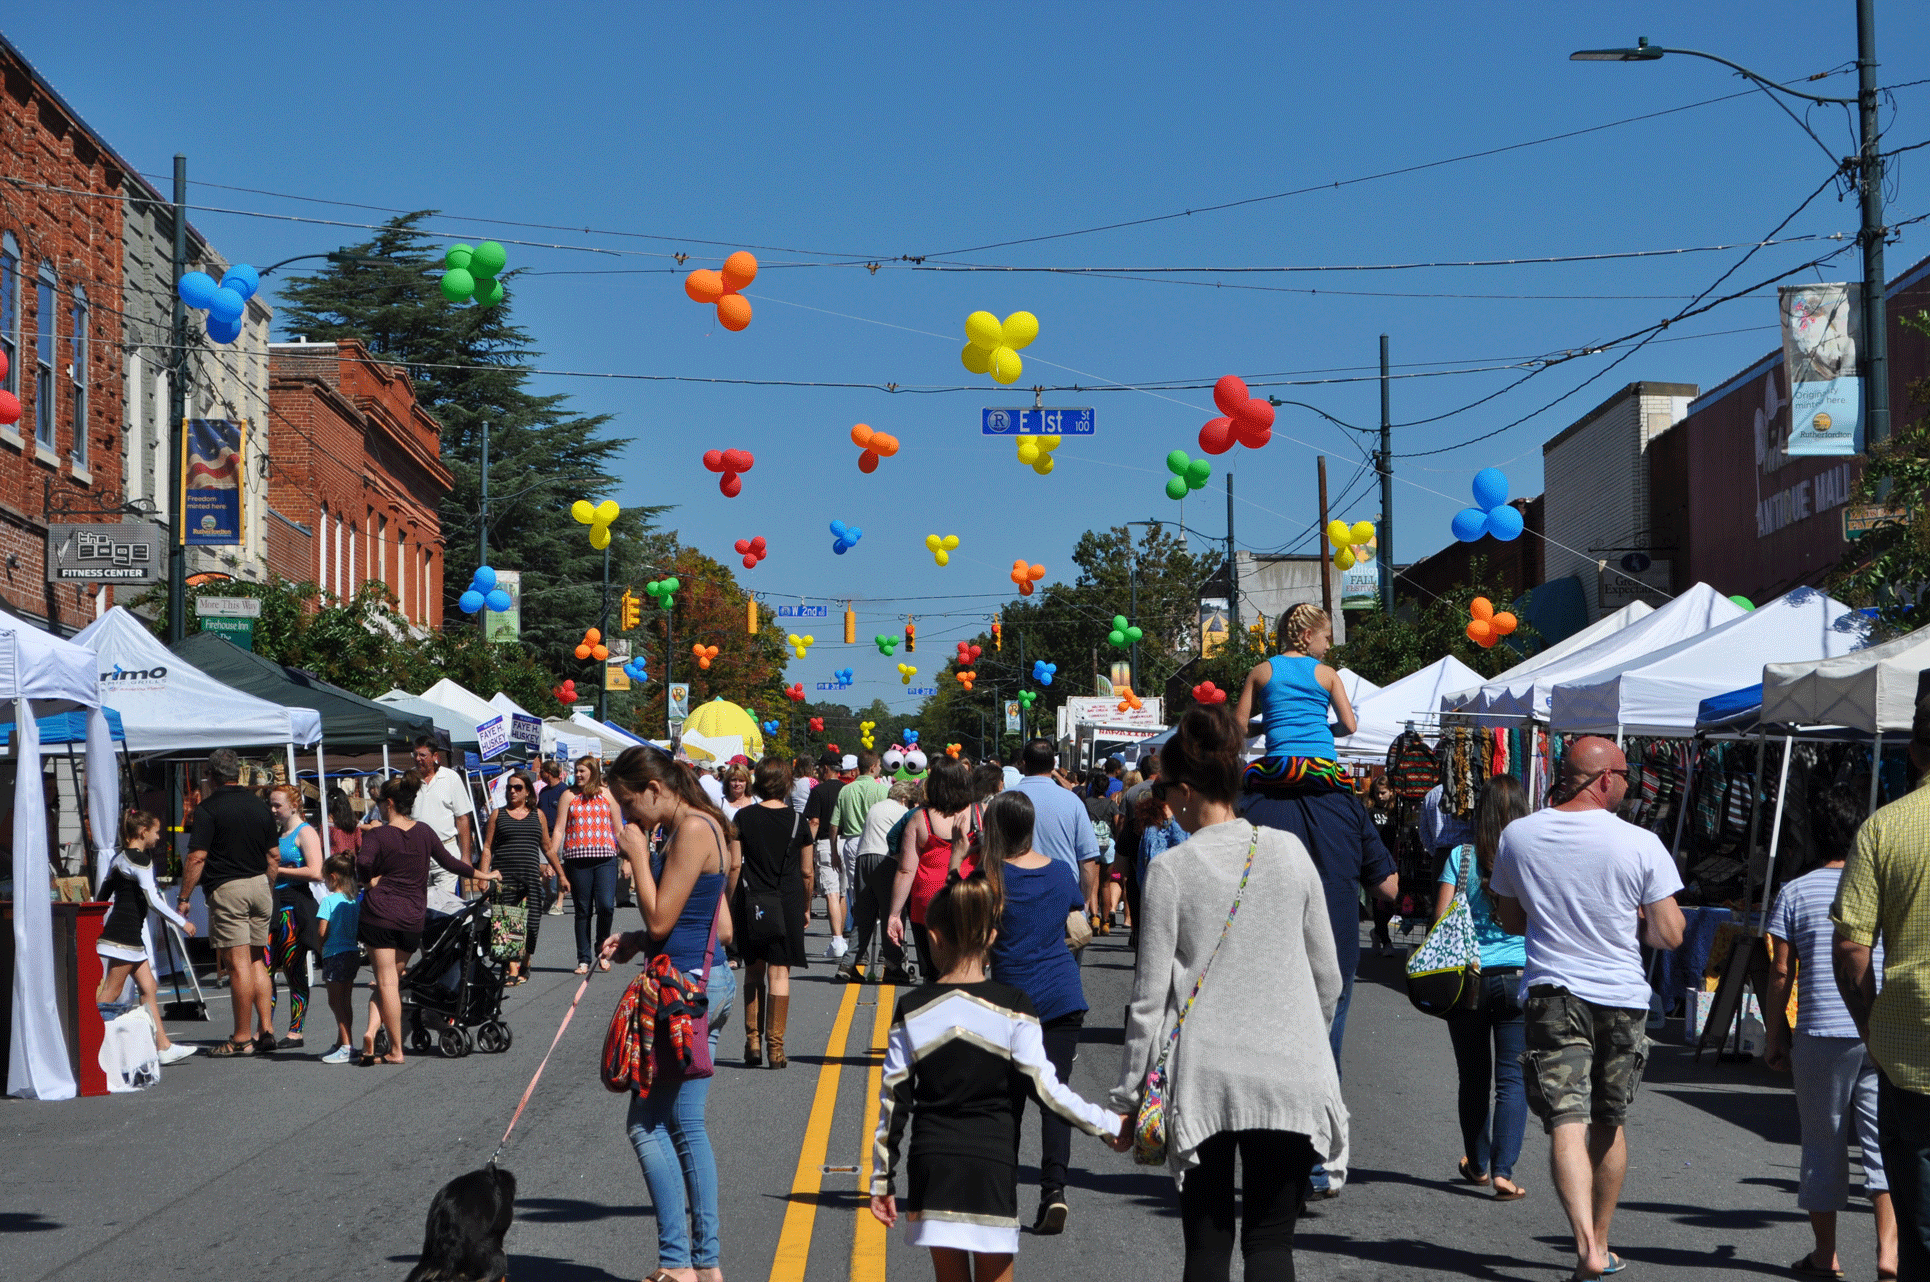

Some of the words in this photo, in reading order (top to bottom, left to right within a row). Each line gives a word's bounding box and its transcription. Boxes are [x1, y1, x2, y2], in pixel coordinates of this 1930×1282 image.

[1795, 387, 1839, 400] Originty
[1019, 410, 1031, 432] E
[1040, 410, 1063, 432] 1st
[1081, 411, 1091, 420] St
[1075, 421, 1090, 432] 100
[1800, 431, 1853, 439] Rutherfordton
[1756, 480, 1811, 538] ANTIQUE
[77, 539, 149, 567] edge
[62, 569, 103, 577] FITNESS
[103, 569, 143, 577] CENTER
[1350, 575, 1376, 584] FALL
[199, 599, 220, 609] More
[221, 600, 240, 610] This
[241, 600, 258, 613] Way
[792, 606, 799, 616] W
[802, 606, 818, 616] 2nd
[205, 619, 238, 630] Firehouse
[238, 621, 249, 630] Inn
[99, 663, 168, 682] rimo
[512, 720, 531, 732] FAYE
[480, 726, 497, 741] FAYE
[511, 730, 540, 744] HUSKEY
[481, 732, 507, 752] HUSKEY
